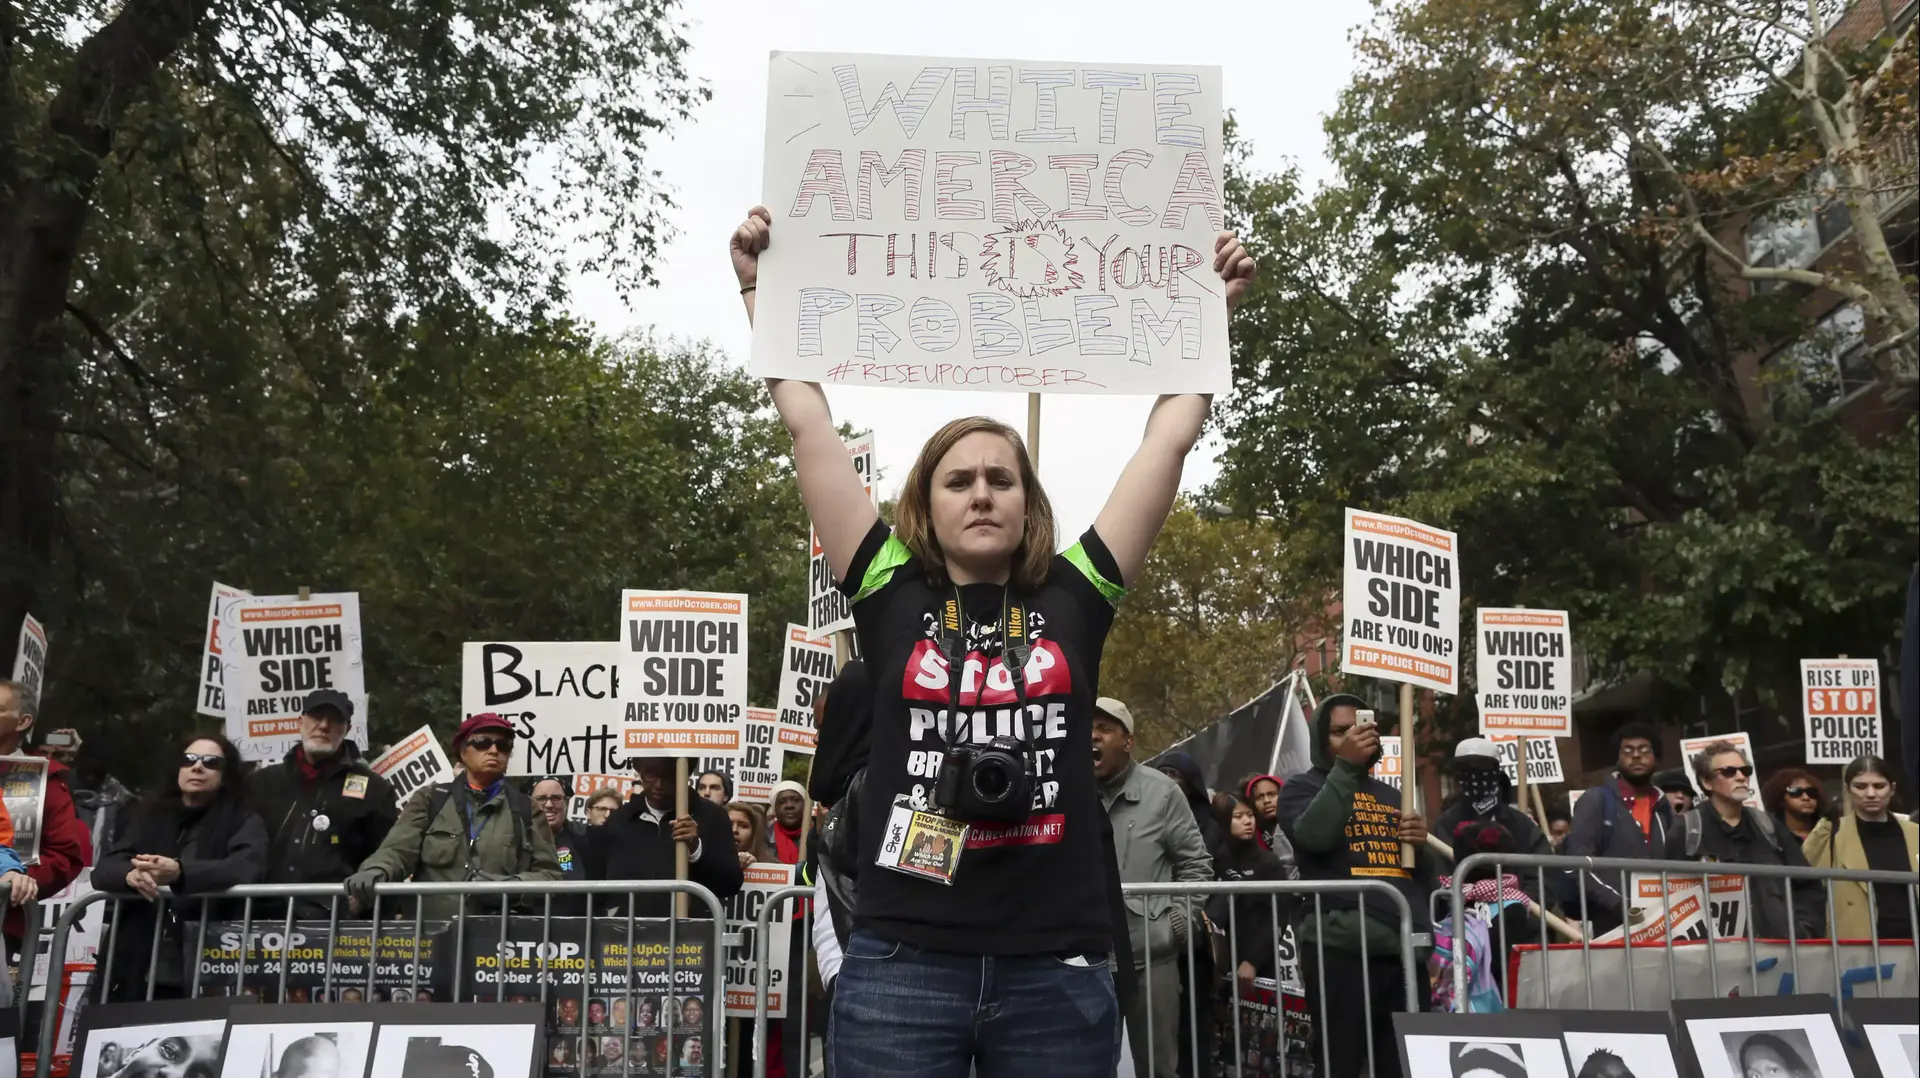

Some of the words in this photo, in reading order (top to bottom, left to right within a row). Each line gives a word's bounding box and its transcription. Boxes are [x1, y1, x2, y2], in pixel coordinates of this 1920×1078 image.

[832, 64, 1206, 149] WHITE
[789, 149, 1223, 231] AMERICA
[819, 231, 979, 279] THIS
[1006, 233, 1060, 286] IS
[1080, 234, 1219, 299] YOUR
[797, 287, 1201, 365] PROBLEM
[827, 360, 1106, 388] #RISEUPOCTOBER
[1353, 538, 1451, 589] WHICH
[811, 591, 852, 630] TERRO
[1368, 577, 1440, 629] SIDE
[945, 599, 959, 631] Nikon
[1008, 606, 1023, 638] Nikon
[243, 624, 342, 657] WHICH
[629, 620, 738, 654] WHICH
[1351, 618, 1383, 642] ARE
[1387, 625, 1419, 650] YOU
[1422, 633, 1453, 657] ON?
[1484, 630, 1564, 657] WHICH
[259, 656, 333, 693] SIDE
[914, 646, 1056, 693] STOP
[1354, 650, 1380, 663] STOP
[1381, 653, 1413, 671] POLICE
[1414, 660, 1449, 679] TERROR!
[1497, 659, 1555, 690] SIDE
[643, 656, 724, 697] SIDE
[1807, 669, 1842, 686] RISE
[1852, 669, 1876, 687] UP!
[247, 698, 278, 715] ARE
[280, 696, 307, 713] YO
[1484, 693, 1510, 709] ARE
[1512, 694, 1538, 709] YOU
[1541, 695, 1567, 710] ON?
[1811, 690, 1873, 711] STOP
[624, 702, 660, 722] ARE
[663, 703, 700, 722] YOU
[703, 703, 740, 722] ON?
[780, 708, 804, 726] ARE
[1487, 716, 1506, 726] STOP
[1508, 716, 1534, 727] POLICE
[252, 722, 276, 733] STOP
[278, 721, 300, 732] POLI
[909, 703, 1067, 745] POLICE
[1810, 716, 1878, 739] POLICE
[628, 733, 655, 744] STOP
[657, 733, 693, 744] POLICE
[694, 733, 736, 745] TERROR!
[994, 742, 1011, 750] Nikon
[1811, 740, 1878, 758] TERROR!
[1497, 740, 1554, 763] POICE
[386, 748, 442, 798] HICH
[740, 770, 755, 783] OU
[757, 772, 778, 784] ON?
[1501, 761, 1559, 780] TEROR!
[579, 775, 633, 797] STOP
[915, 813, 936, 824] STOP
[1345, 824, 1398, 838] GENOCID
[913, 851, 931, 859] Which
[1381, 842, 1398, 852] STO
[220, 932, 307, 951] STOP
[496, 941, 580, 960] STOP
[291, 961, 326, 974] 2015
[404, 963, 433, 978] Cty
[603, 957, 628, 967] Which
[651, 957, 666, 967] Are
[685, 956, 702, 967] On?
[637, 971, 670, 985] York
[674, 971, 703, 986] City
